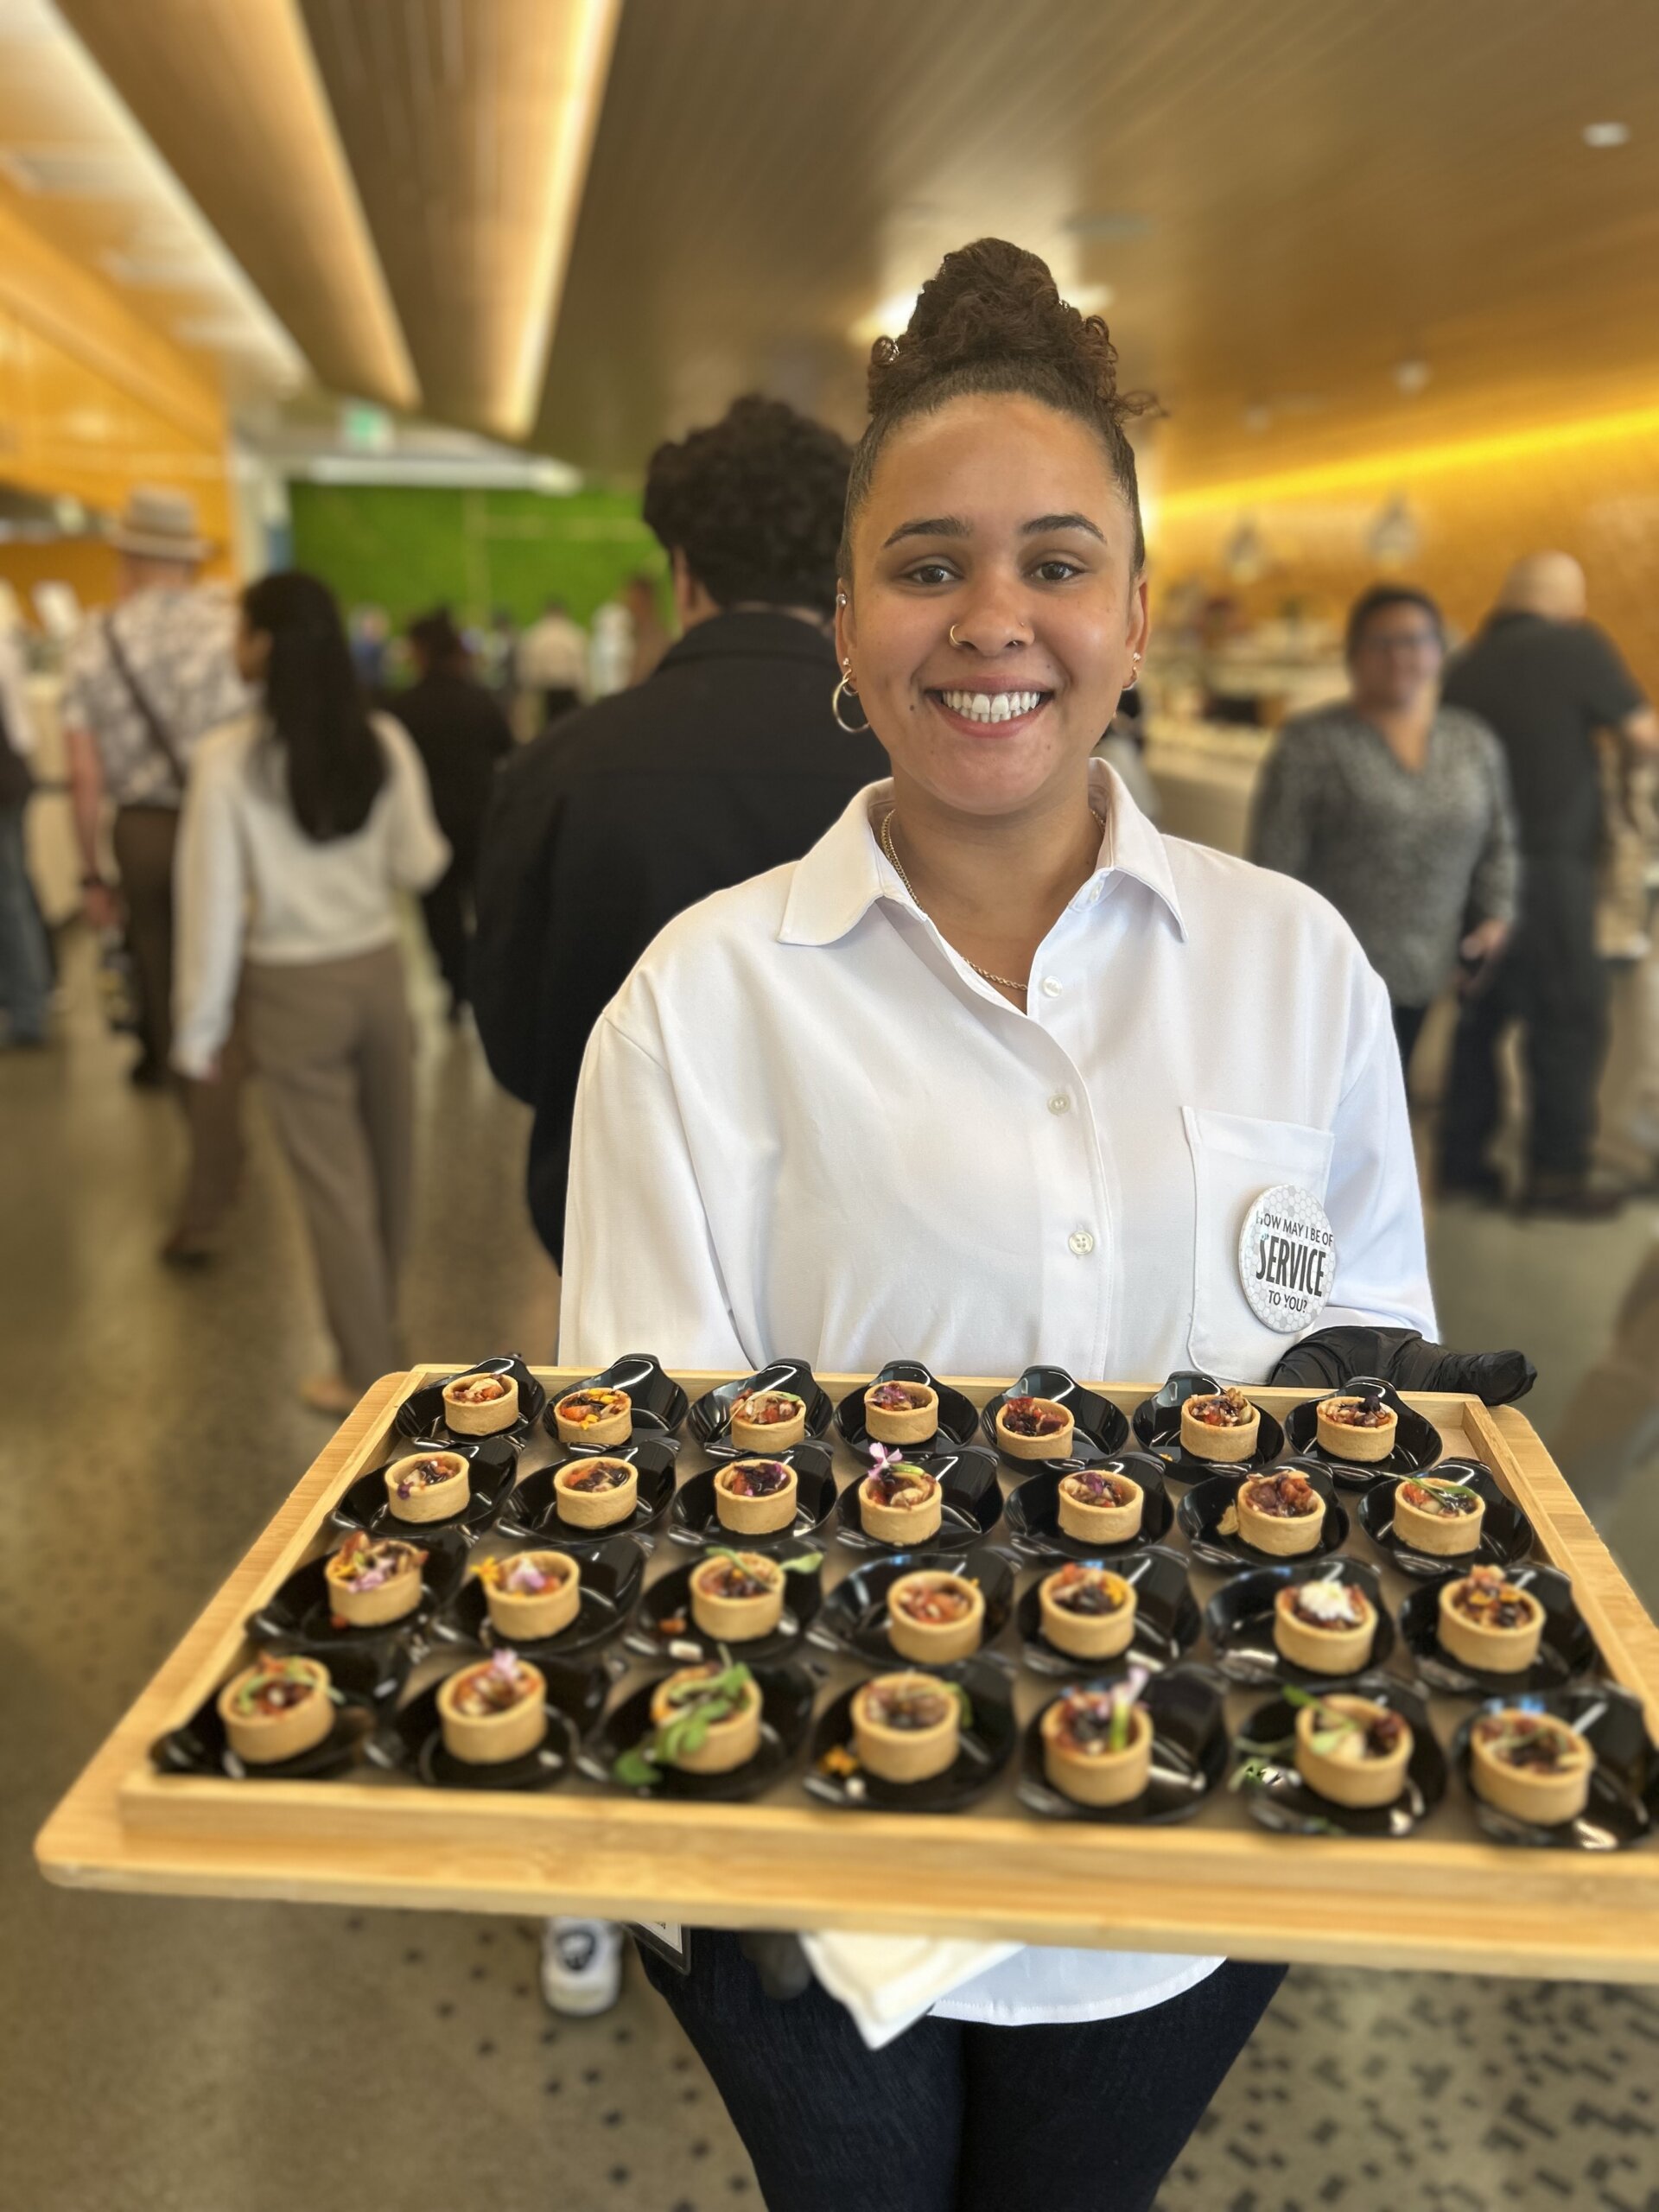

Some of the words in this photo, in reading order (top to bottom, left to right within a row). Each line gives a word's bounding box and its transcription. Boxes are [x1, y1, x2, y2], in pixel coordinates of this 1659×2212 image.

[1282, 1218, 1304, 1236] MAY
[1305, 1226, 1308, 1239] I
[1310, 1227, 1321, 1243] BE
[1321, 1232, 1333, 1247] OF
[1255, 1233, 1326, 1297] SERVICE
[1268, 1289, 1281, 1306] TO
[1284, 1294, 1307, 1313] YOU?
